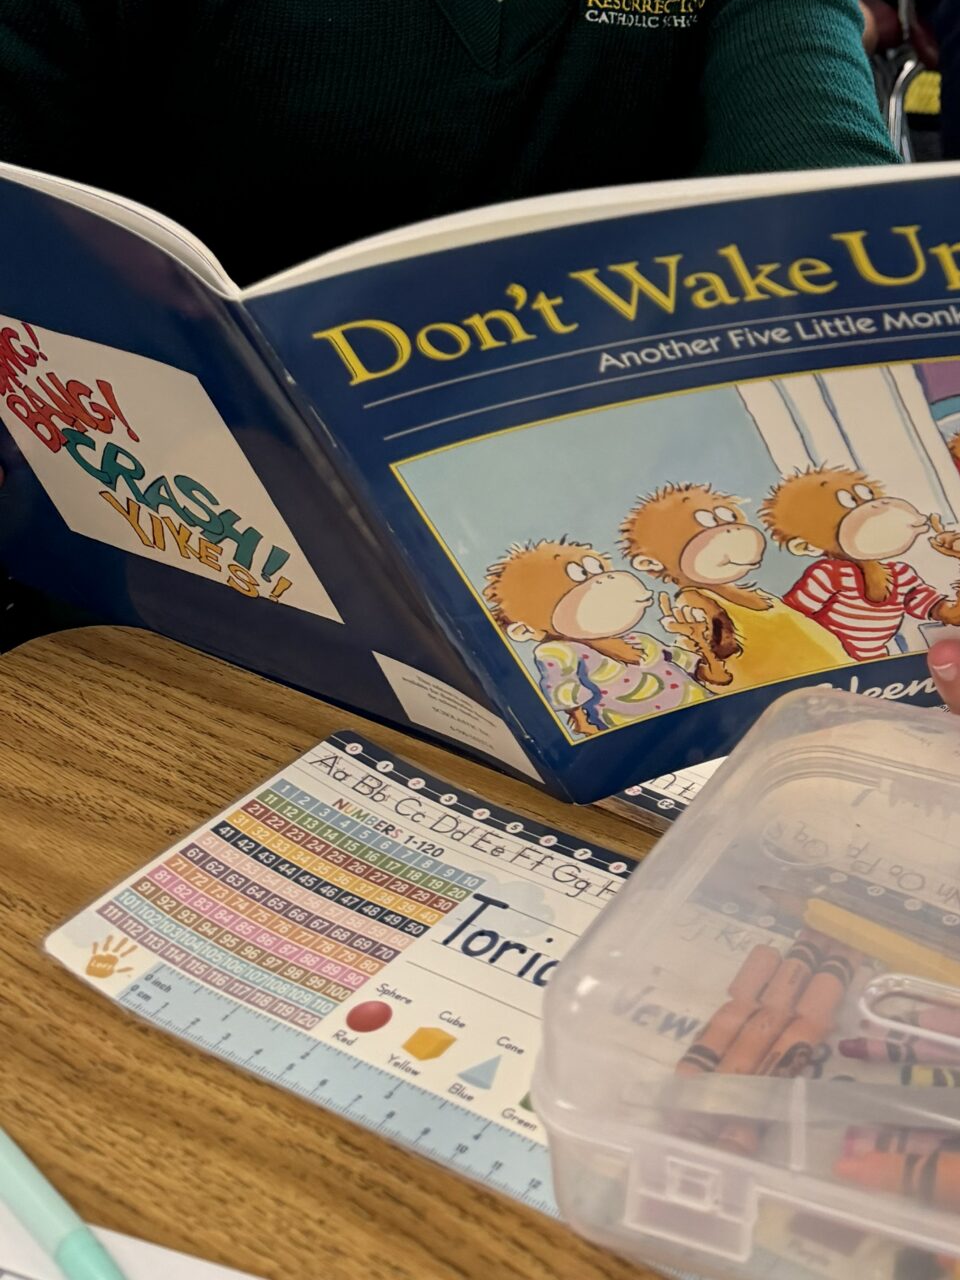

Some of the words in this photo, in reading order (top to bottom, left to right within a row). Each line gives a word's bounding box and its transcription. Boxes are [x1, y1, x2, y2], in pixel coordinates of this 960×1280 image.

[585, 10, 660, 28] CATHOLIC
[312, 283, 579, 387] Don't
[569, 243, 839, 322] Wake
[599, 335, 723, 374] Another
[727, 326, 793, 350] Five
[795, 313, 876, 342] Little
[6, 371, 141, 454] BANG!
[61, 428, 291, 582] CRASH!
[99, 490, 293, 603] YIKES!
[249, 804, 264, 816] 21
[267, 816, 284, 829] 22
[287, 828, 304, 841] 23
[307, 840, 325, 852] 24
[328, 851, 345, 863] 25
[349, 861, 366, 874] 26
[370, 871, 387, 883] 27
[391, 880, 408, 893] 28
[413, 890, 430, 902] 29
[434, 898, 451, 911] 30
[263, 793, 278, 804] 11
[282, 806, 299, 818] 12
[301, 818, 319, 830] 13
[322, 829, 339, 841] 14
[342, 840, 359, 852] 15
[363, 850, 380, 862] 16
[384, 860, 401, 872] 17
[405, 869, 422, 881] 18
[427, 878, 444, 890] 19
[448, 887, 465, 900] 20
[309, 755, 351, 782] Aa
[352, 774, 390, 802] Bb
[395, 797, 426, 823] Cc
[430, 814, 479, 841] Dd
[471, 832, 505, 857] Ee
[510, 847, 554, 871] Ff
[552, 864, 591, 897] Gg
[332, 798, 404, 839] NUMBERS
[404, 835, 445, 858] 1-120
[187, 847, 203, 860] 61
[206, 861, 224, 874] 62
[226, 874, 244, 886] 63
[247, 886, 265, 899] 64
[268, 897, 285, 910] 65
[289, 908, 307, 921] 66
[310, 918, 328, 931] 67
[332, 928, 350, 941] 68
[353, 937, 371, 950] 69
[375, 946, 393, 959] 70
[219, 825, 234, 837] 41
[237, 838, 255, 851] 42
[257, 851, 275, 863] 43
[278, 862, 295, 875] 44
[298, 874, 316, 886] 45
[319, 884, 337, 897] 46
[341, 894, 358, 907] 47
[362, 904, 380, 916] 48
[384, 913, 401, 926] 49
[405, 922, 423, 934] 50
[462, 876, 479, 888] 10
[137, 990, 152, 1002] cm
[151, 975, 172, 993] inch
[376, 982, 413, 1004] Sphere
[438, 1010, 466, 1028] Cube
[496, 1036, 524, 1055] Cone
[331, 1029, 359, 1047] Red
[387, 1052, 421, 1077] Yellow
[448, 1082, 475, 1102] Blue
[501, 1106, 538, 1131] Green
